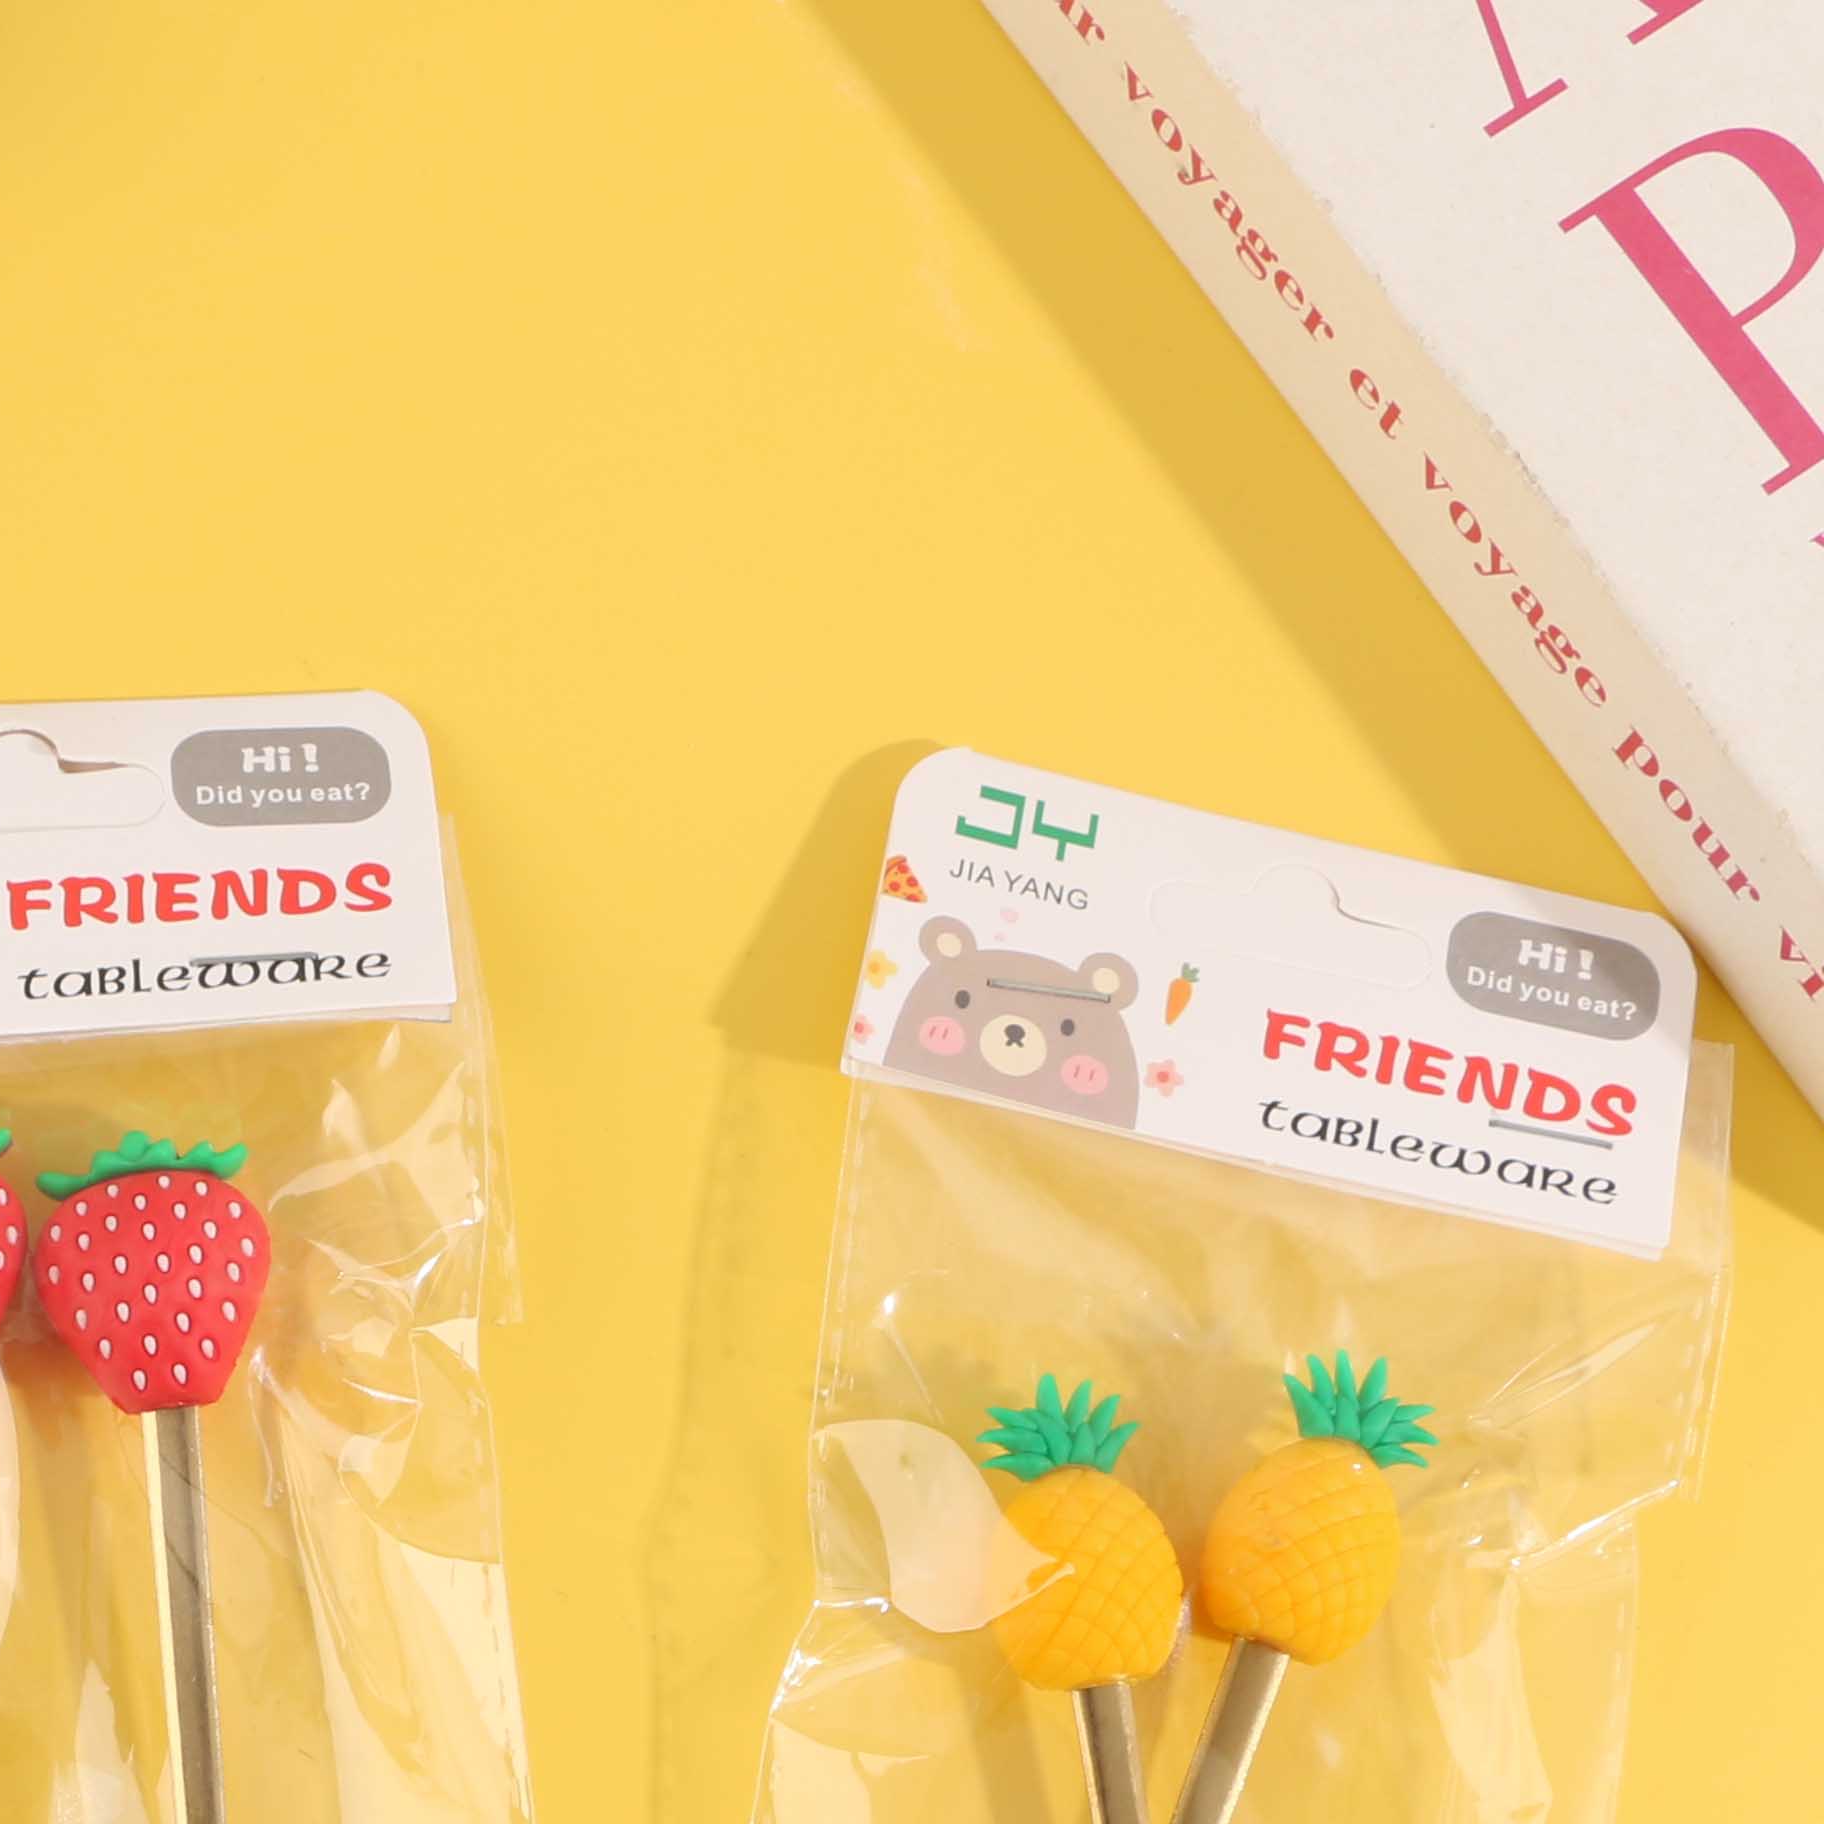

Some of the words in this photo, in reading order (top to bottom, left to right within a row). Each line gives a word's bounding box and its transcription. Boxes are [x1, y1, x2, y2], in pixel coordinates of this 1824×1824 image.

[1125, 61, 1334, 341] voyager
[1349, 367, 1405, 440] et
[1424, 450, 1607, 708] voyage
[1612, 725, 1760, 901] pour
[197, 786, 242, 804] Did
[250, 788, 302, 808] you
[311, 782, 370, 801] eat?
[8, 864, 390, 929] FRIENDS
[1467, 966, 1512, 993] Did
[1519, 980, 1570, 1007] you
[1577, 994, 1638, 1021] eat?
[1263, 1008, 1637, 1136] FRIENDS
